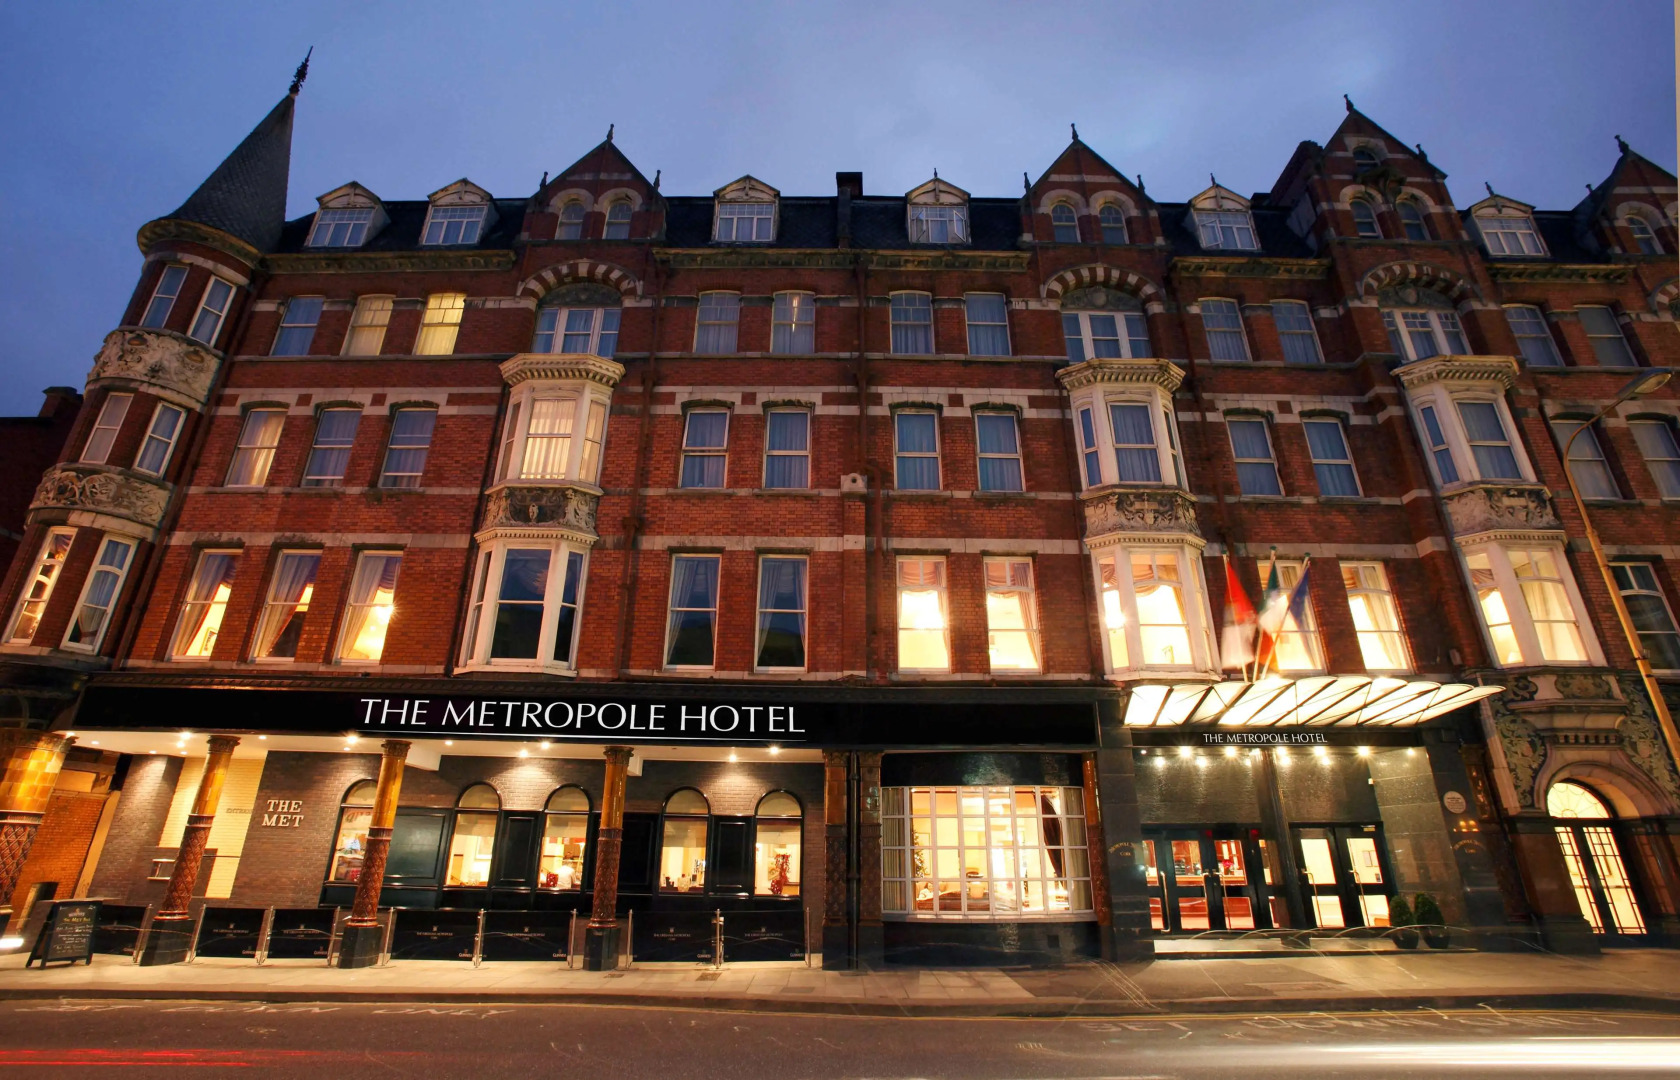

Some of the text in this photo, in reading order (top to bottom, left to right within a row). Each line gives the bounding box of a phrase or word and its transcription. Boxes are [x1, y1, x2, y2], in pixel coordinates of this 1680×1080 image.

[361, 699, 806, 733] THE METROPOLE HOTEL
[1203, 733, 1328, 743] THE METROPOLE HOTEL
[267, 799, 303, 813] THE
[261, 814, 304, 827] MET
[371, 1008, 516, 1018] ONLY
[1079, 1021, 1192, 1032] SET
